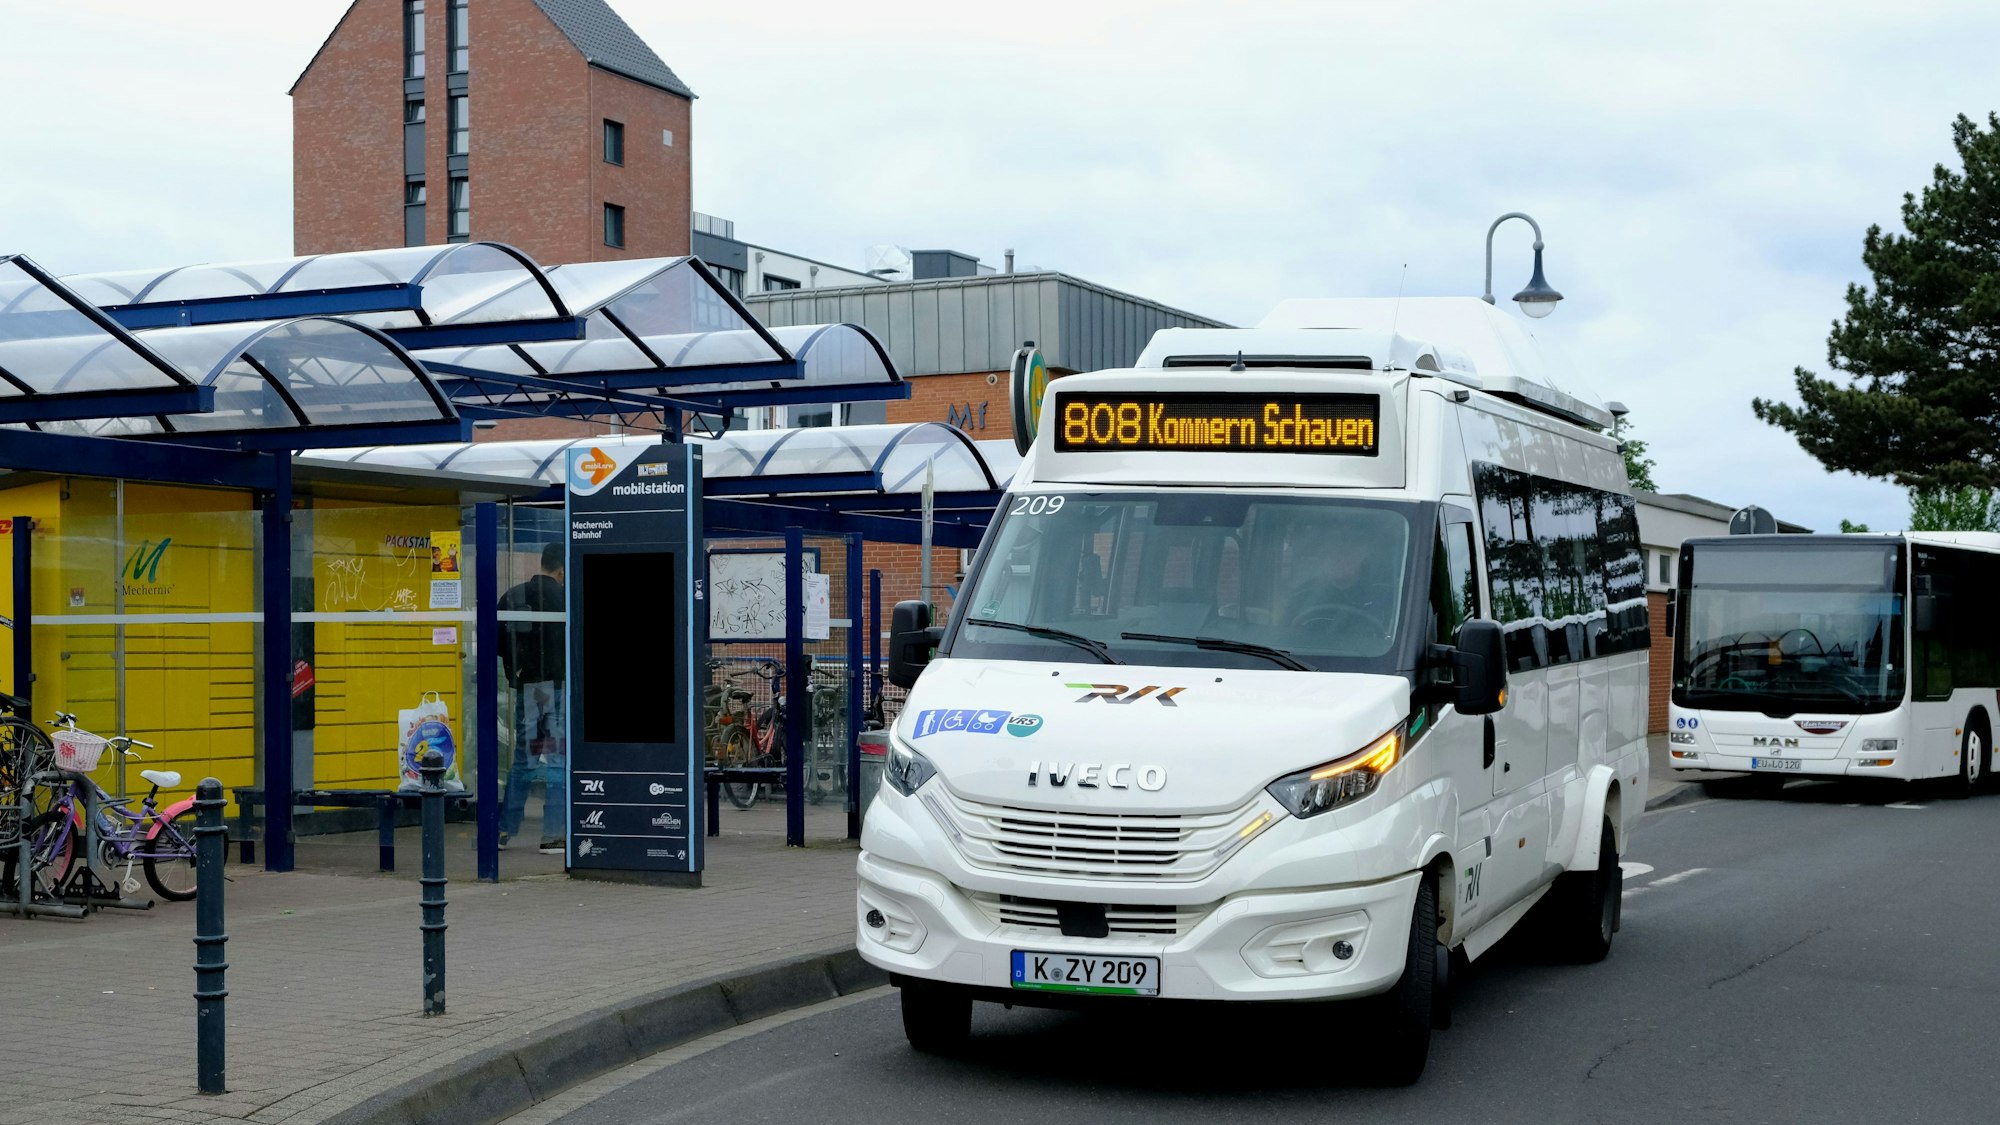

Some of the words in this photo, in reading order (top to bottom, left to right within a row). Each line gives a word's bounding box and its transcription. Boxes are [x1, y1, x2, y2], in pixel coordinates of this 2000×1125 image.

[1064, 402, 1142, 444] 808
[1148, 402, 1256, 446] Kommern
[1263, 402, 1374, 447] Schaven
[612, 481, 685, 495] mobilstation
[1011, 495, 1065, 516] 209
[572, 520, 613, 530] Mechernich
[572, 530, 602, 540] Bahnhof
[385, 535, 430, 549] PACKSTAT
[122, 584, 175, 595] Mechernic
[1008, 715, 1037, 727] VRS
[1753, 737, 1799, 748] MAN
[1757, 759, 1768, 768] EU
[1785, 761, 1800, 769] 120
[1027, 761, 1168, 792] IVECO
[1016, 970, 1022, 978] D
[1034, 956, 1049, 980] K
[1066, 958, 1096, 982] ZY
[1102, 961, 1147, 985] 209
